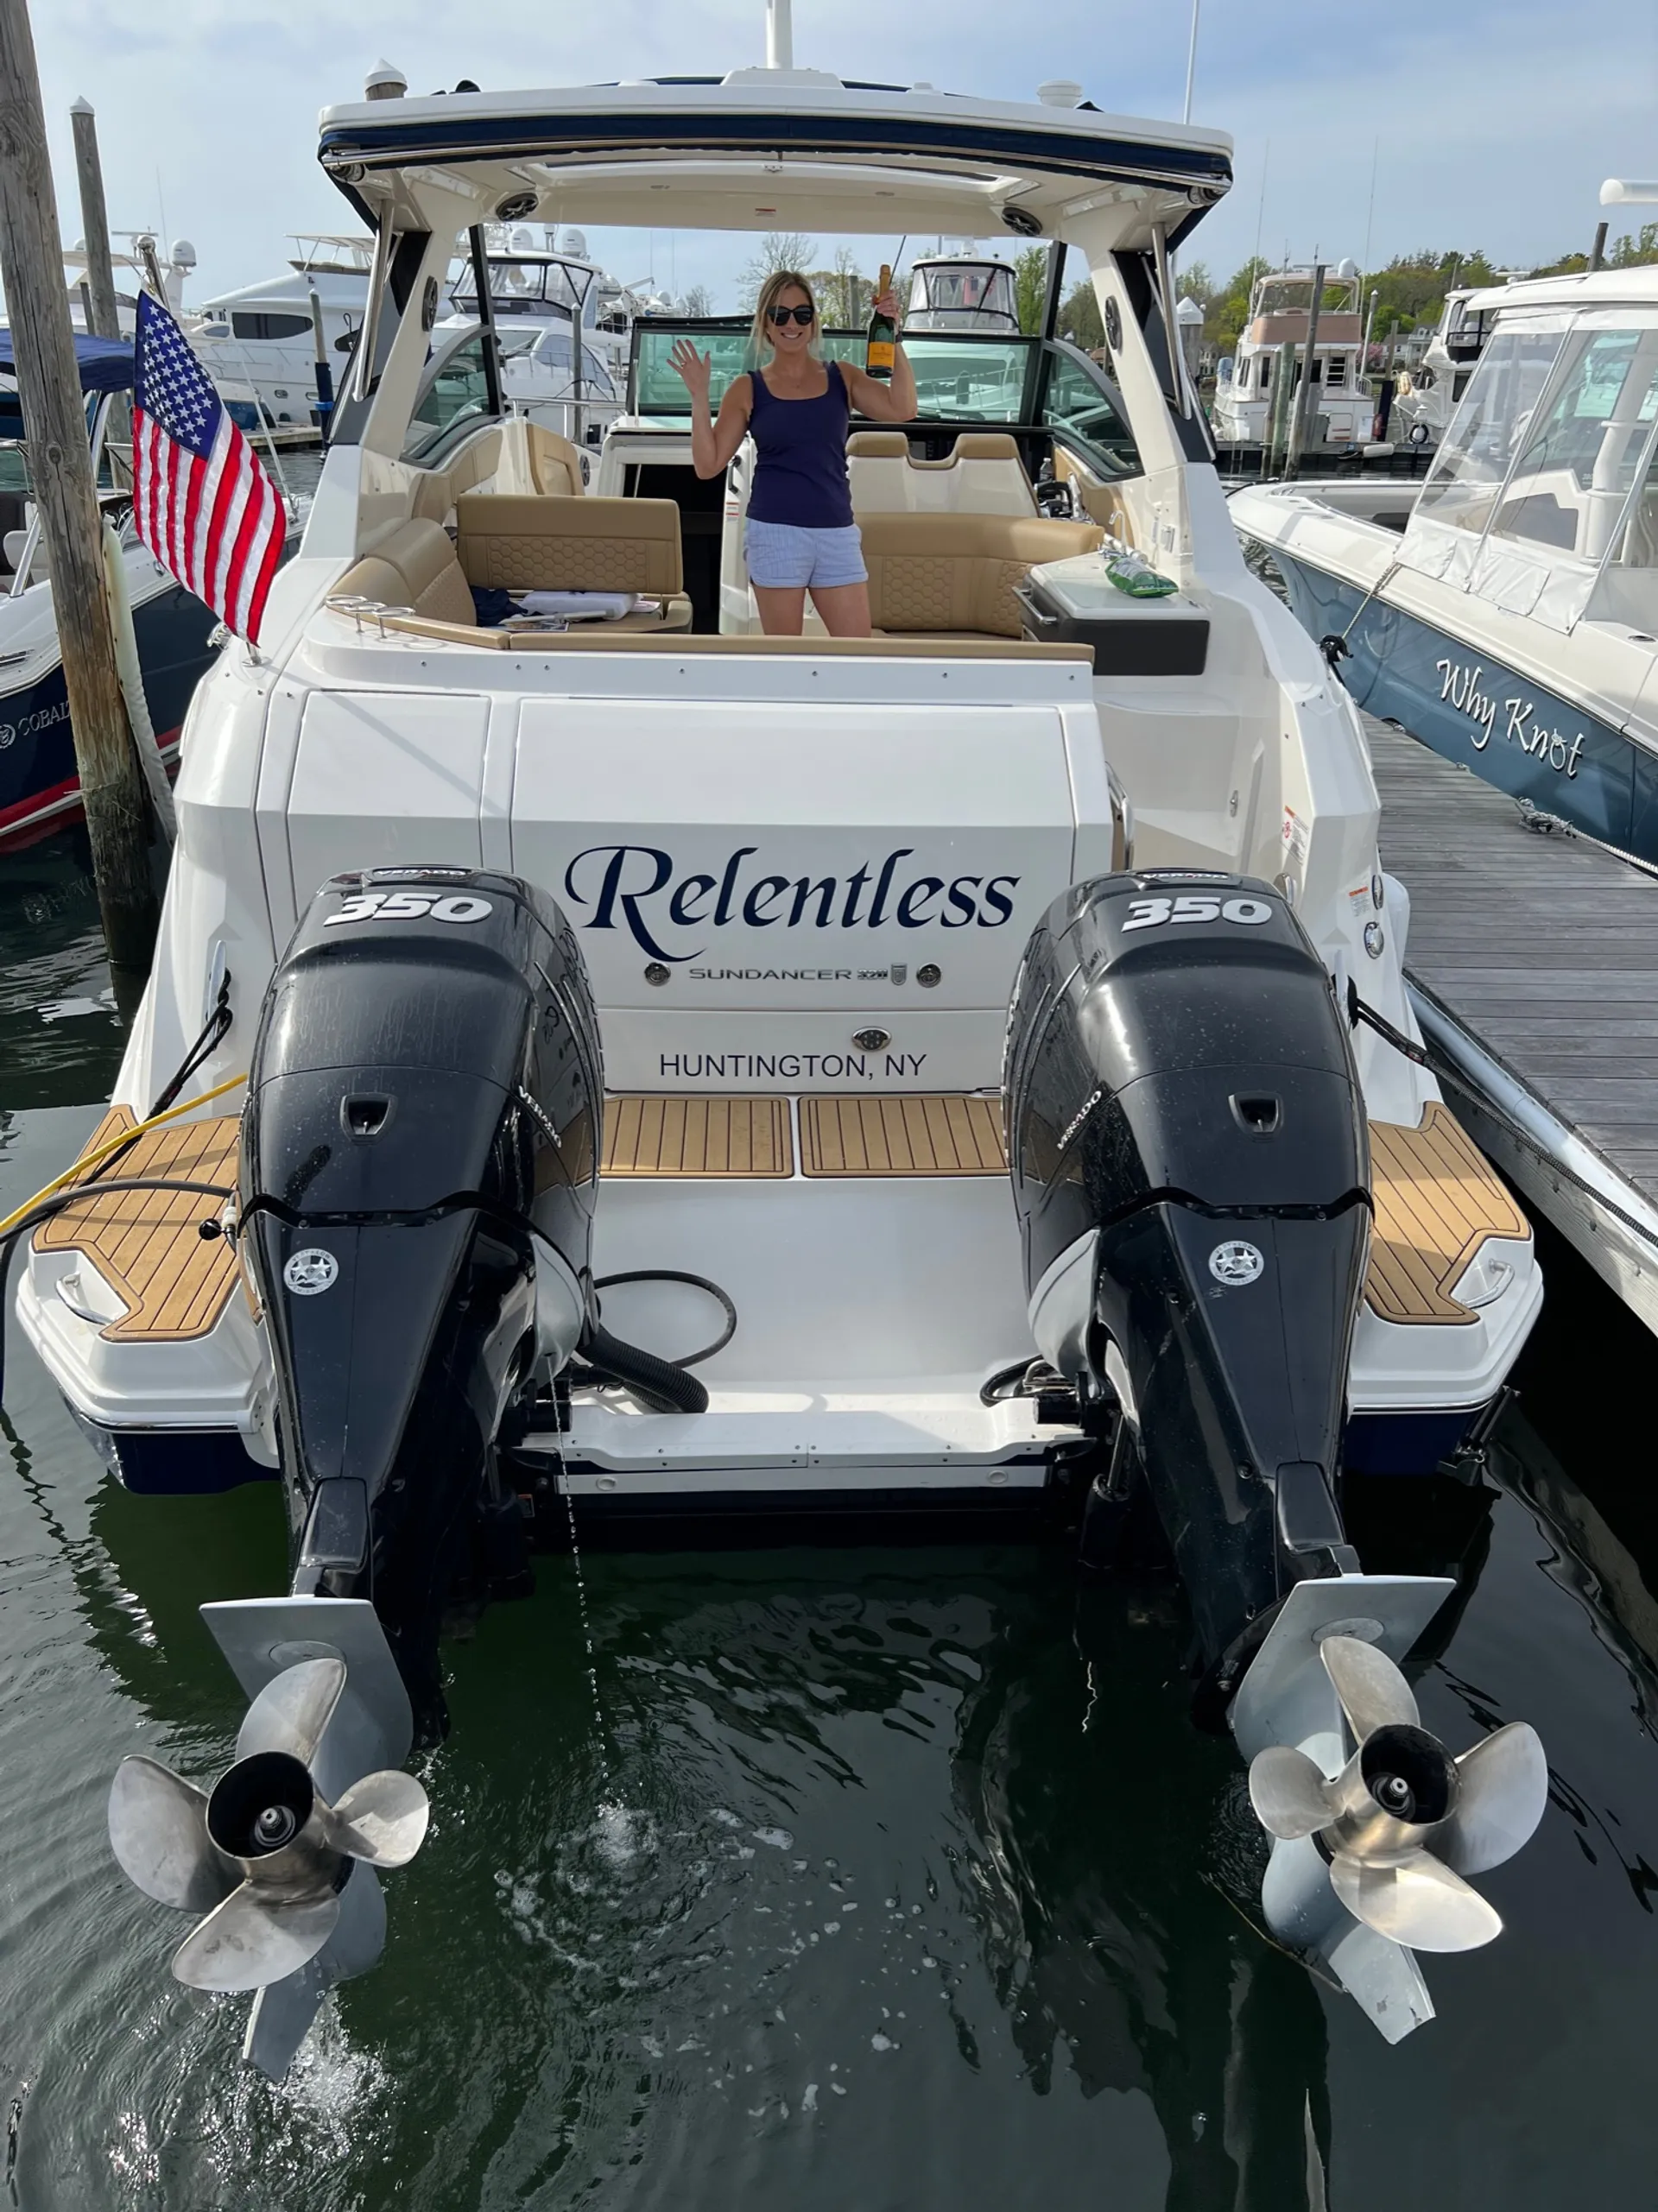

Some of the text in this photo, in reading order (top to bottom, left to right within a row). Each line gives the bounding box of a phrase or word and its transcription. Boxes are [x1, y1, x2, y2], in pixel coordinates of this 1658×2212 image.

[1435, 658, 1586, 778] Why Knot
[323, 892, 494, 927] 350
[564, 845, 1022, 963] Relentless
[1121, 896, 1273, 933] 350
[688, 968, 852, 981] SUNDANCER
[661, 1053, 927, 1081] HUNTINGTON, NY
